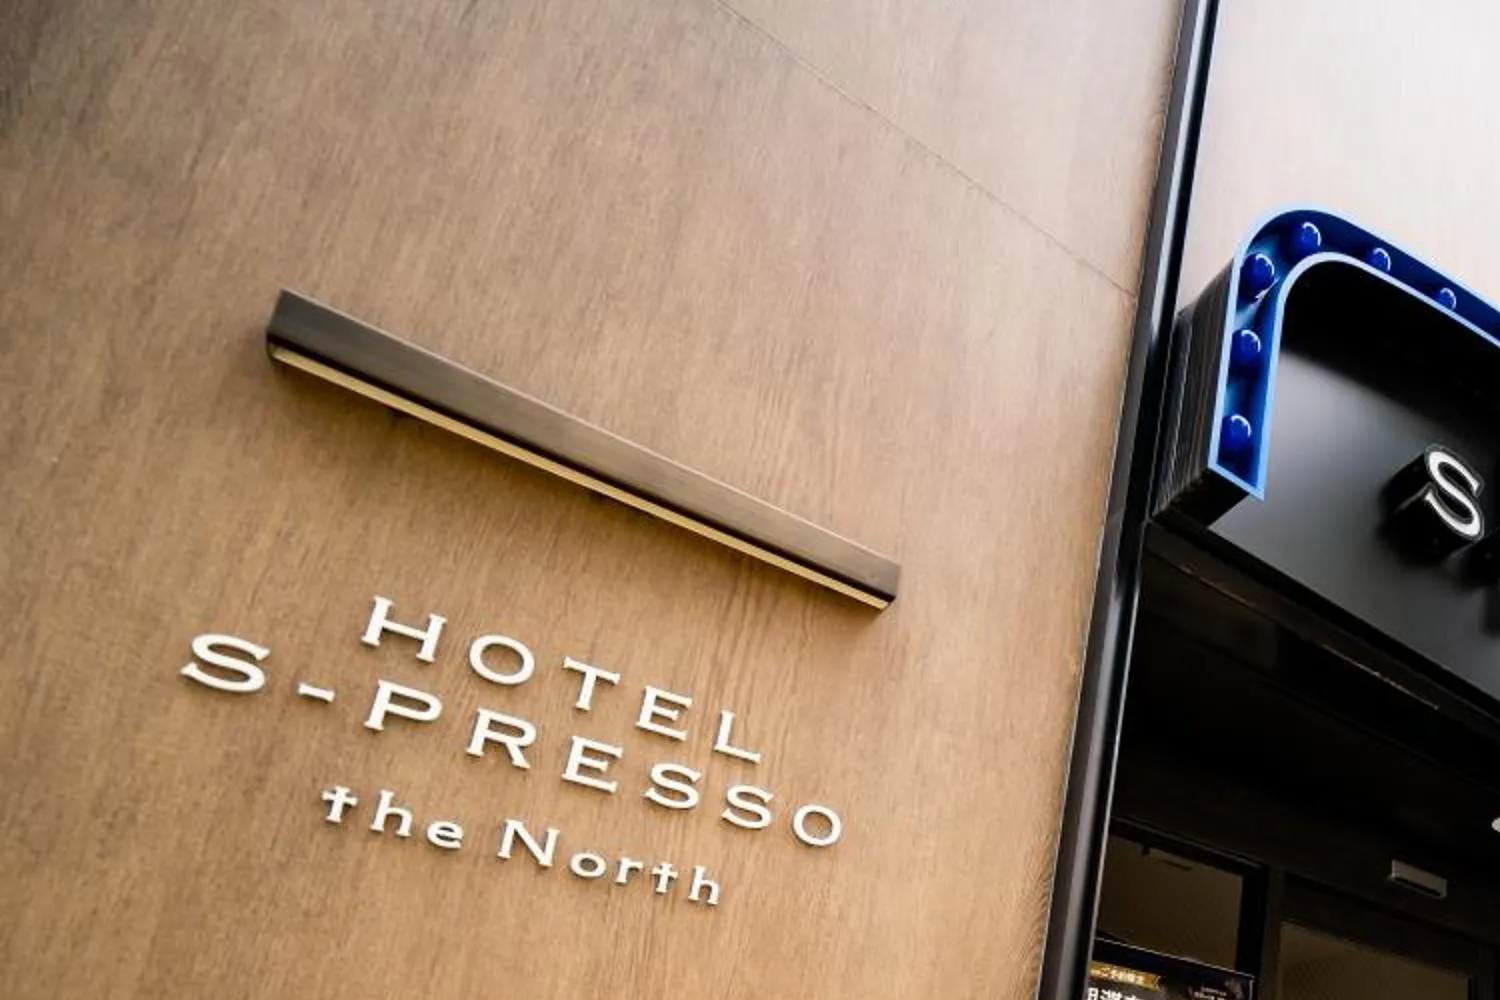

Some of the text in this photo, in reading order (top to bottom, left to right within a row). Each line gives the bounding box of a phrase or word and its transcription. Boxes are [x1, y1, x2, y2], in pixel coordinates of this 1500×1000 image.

[180, 632, 842, 847] S-PRESSO
[360, 595, 760, 764] HOTEL
[322, 786, 721, 906] the North
